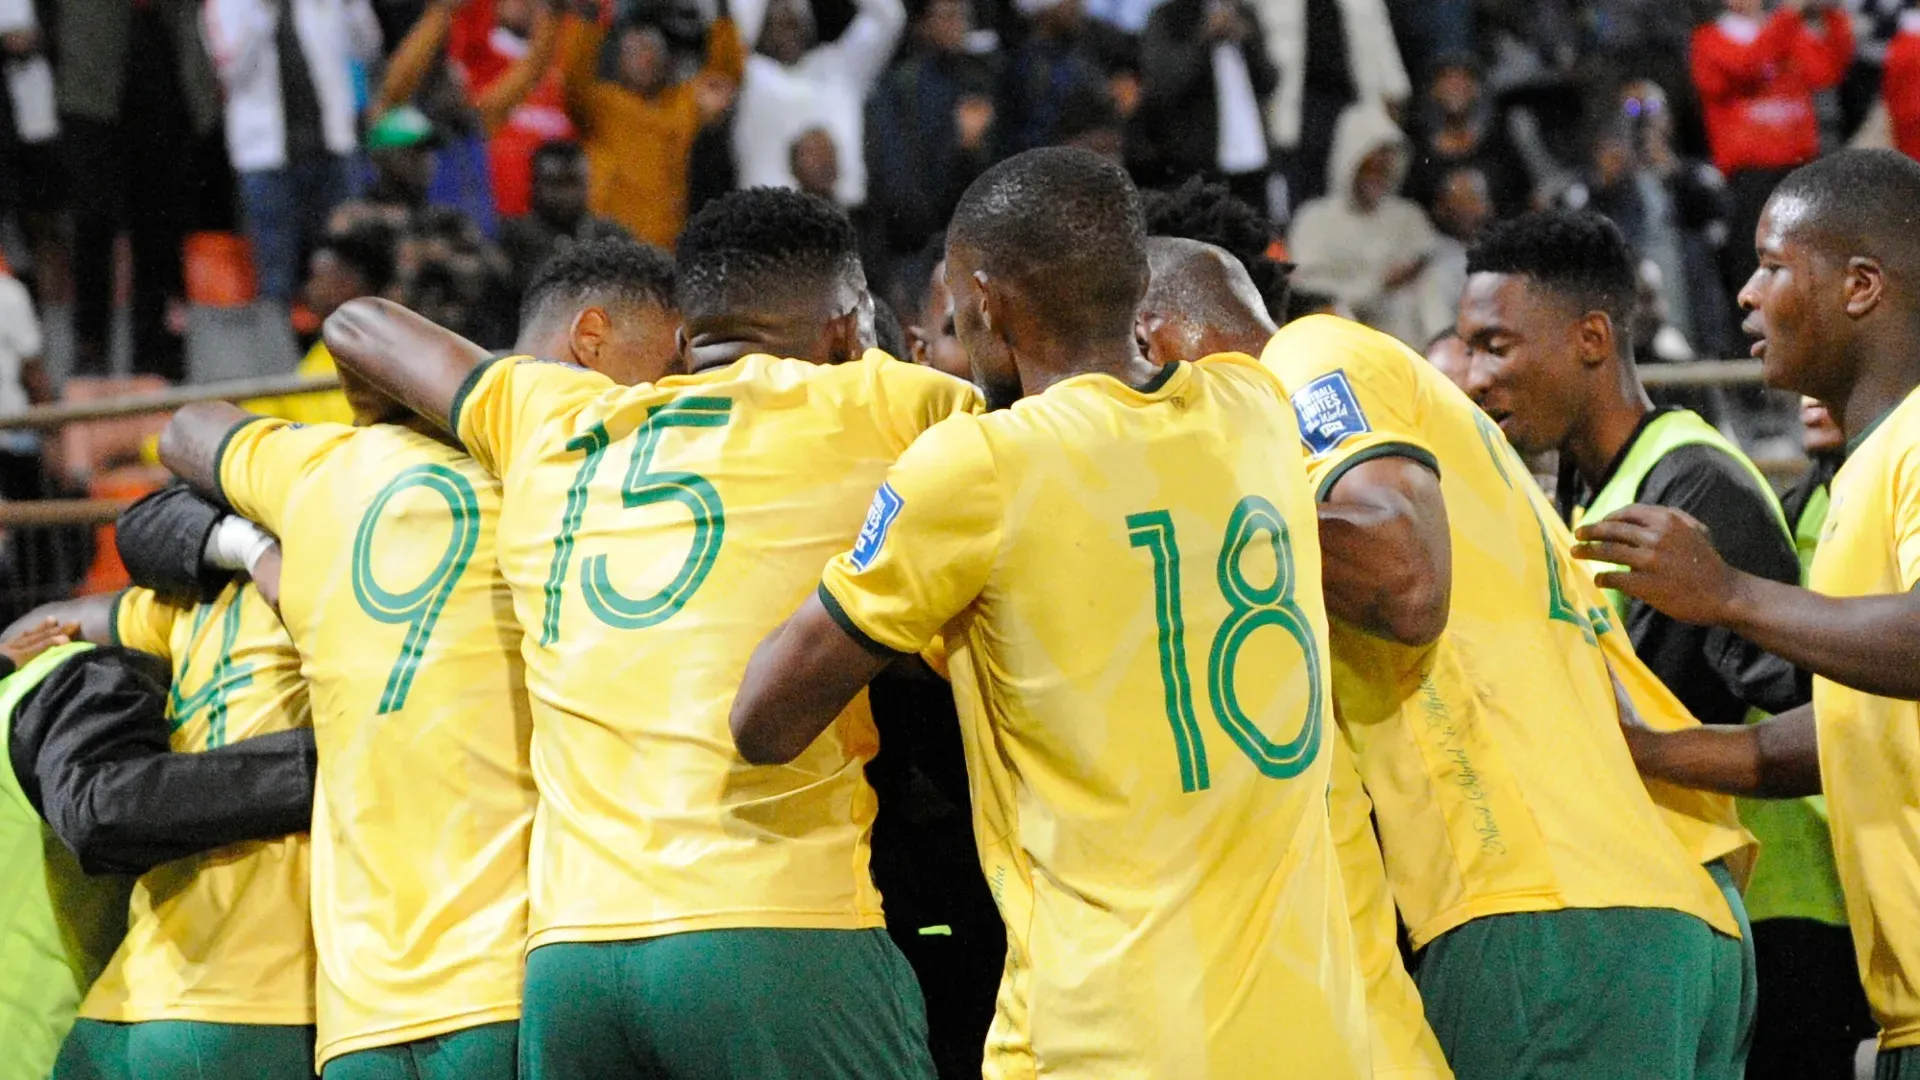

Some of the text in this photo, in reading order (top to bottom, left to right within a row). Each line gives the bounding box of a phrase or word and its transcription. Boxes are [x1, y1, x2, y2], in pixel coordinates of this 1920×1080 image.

[540, 395, 734, 645] 15
[1301, 392, 1341, 421] UNITES
[169, 582, 254, 750] 4
[351, 463, 480, 715] 9
[1125, 494, 1323, 793] 18
